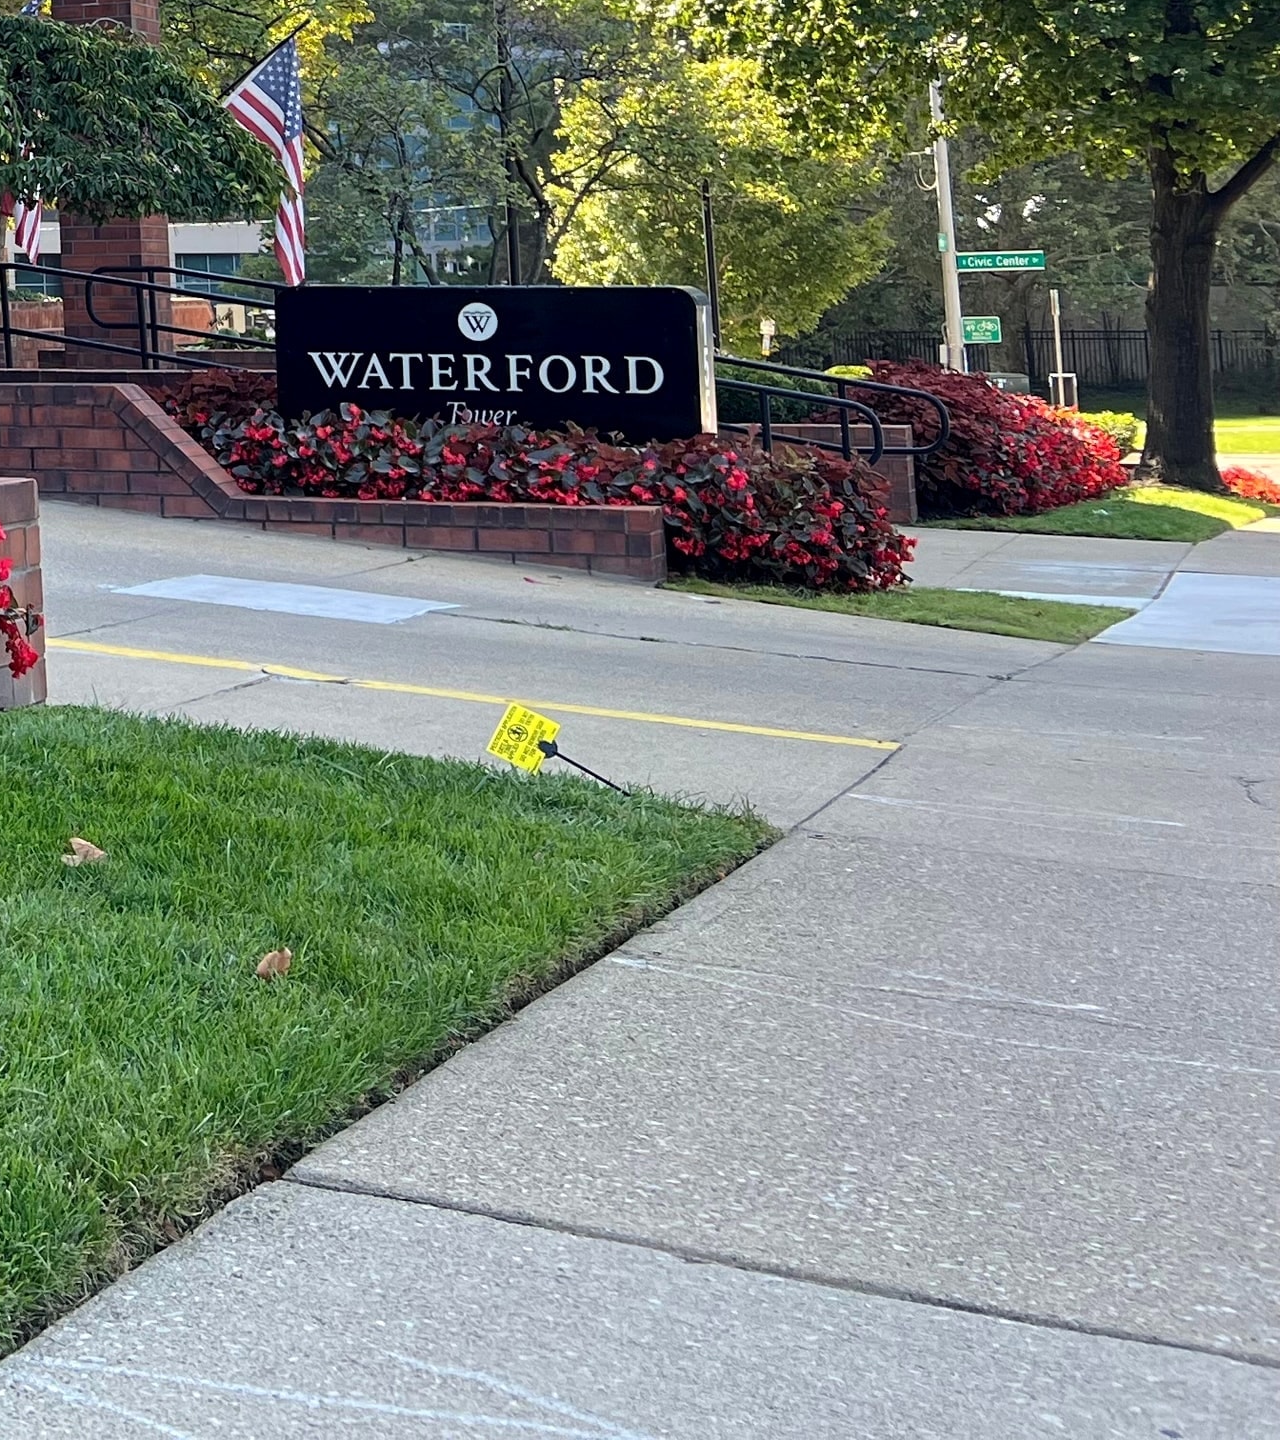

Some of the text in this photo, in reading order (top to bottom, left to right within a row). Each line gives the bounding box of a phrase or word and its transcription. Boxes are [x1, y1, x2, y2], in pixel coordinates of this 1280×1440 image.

[967, 257, 993, 267] Civic
[996, 256, 1029, 266] Center
[464, 315, 491, 333] W
[308, 352, 664, 394] WATERFORD
[446, 401, 517, 426] Tower
